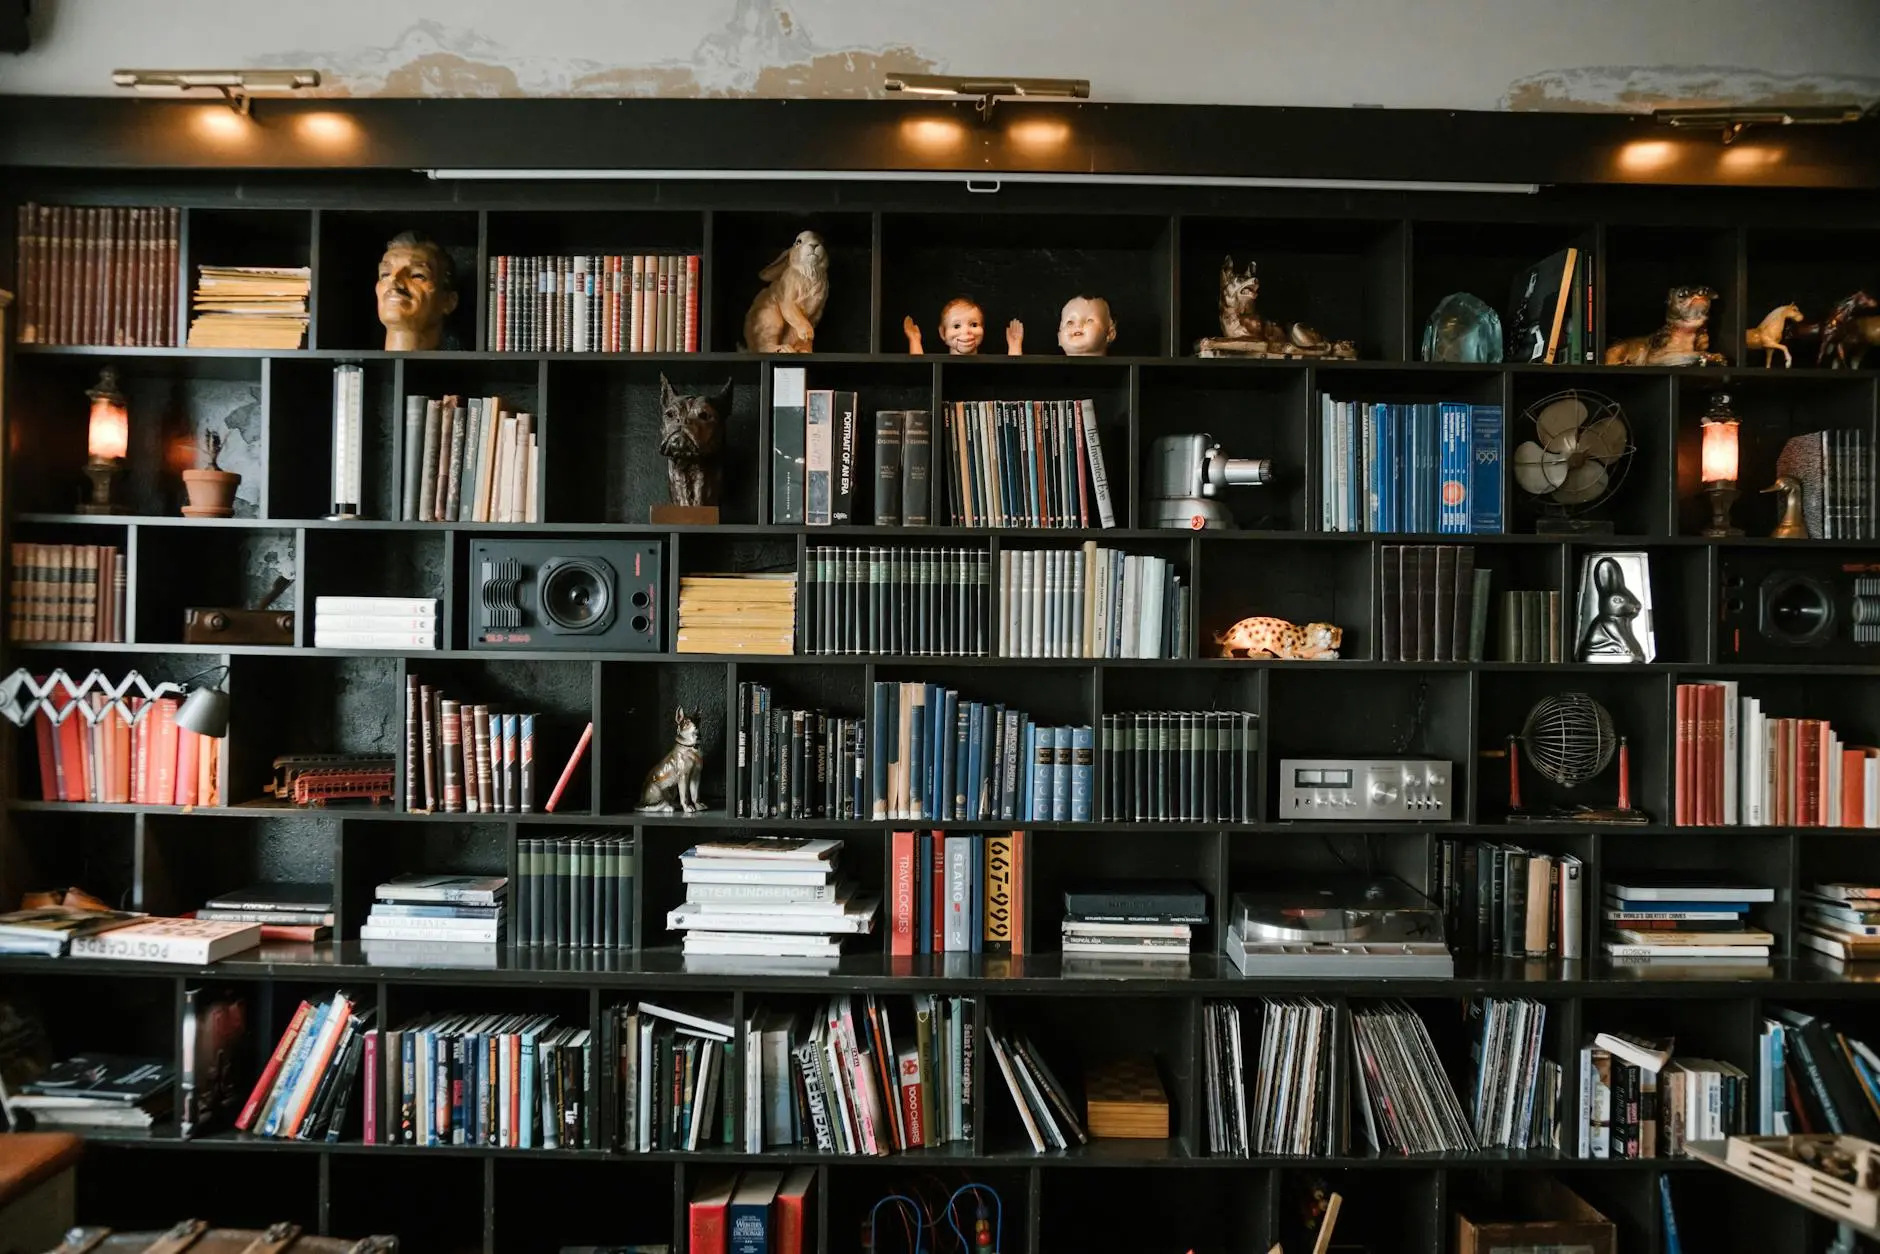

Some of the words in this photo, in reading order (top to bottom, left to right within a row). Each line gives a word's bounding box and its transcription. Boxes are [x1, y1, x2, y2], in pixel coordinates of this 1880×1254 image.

[842, 411, 852, 451] PORTRAIT
[1087, 427, 1098, 444] The
[842, 452, 851, 464] OF
[1090, 443, 1104, 484] Invented
[1475, 450, 1498, 465] 1991
[841, 464, 850, 478] AN
[840, 477, 850, 496] ERA
[1096, 483, 1108, 502] Eve
[407, 731, 417, 789] ICELAND
[1009, 753, 1017, 763] TO
[1006, 762, 1016, 793] AMERICA
[952, 852, 964, 902] SLANG
[990, 840, 1010, 938] 667-999
[690, 886, 732, 898] PETER
[735, 886, 811, 898] LINDBERGH
[897, 855, 910, 934] TRAVELOGUES
[78, 938, 170, 958] POSTCARDS
[963, 1022, 973, 1050] Saint
[961, 1050, 973, 1105] Petersburg
[907, 1085, 918, 1109] 1000
[909, 1109, 921, 1144] CHAIRS
